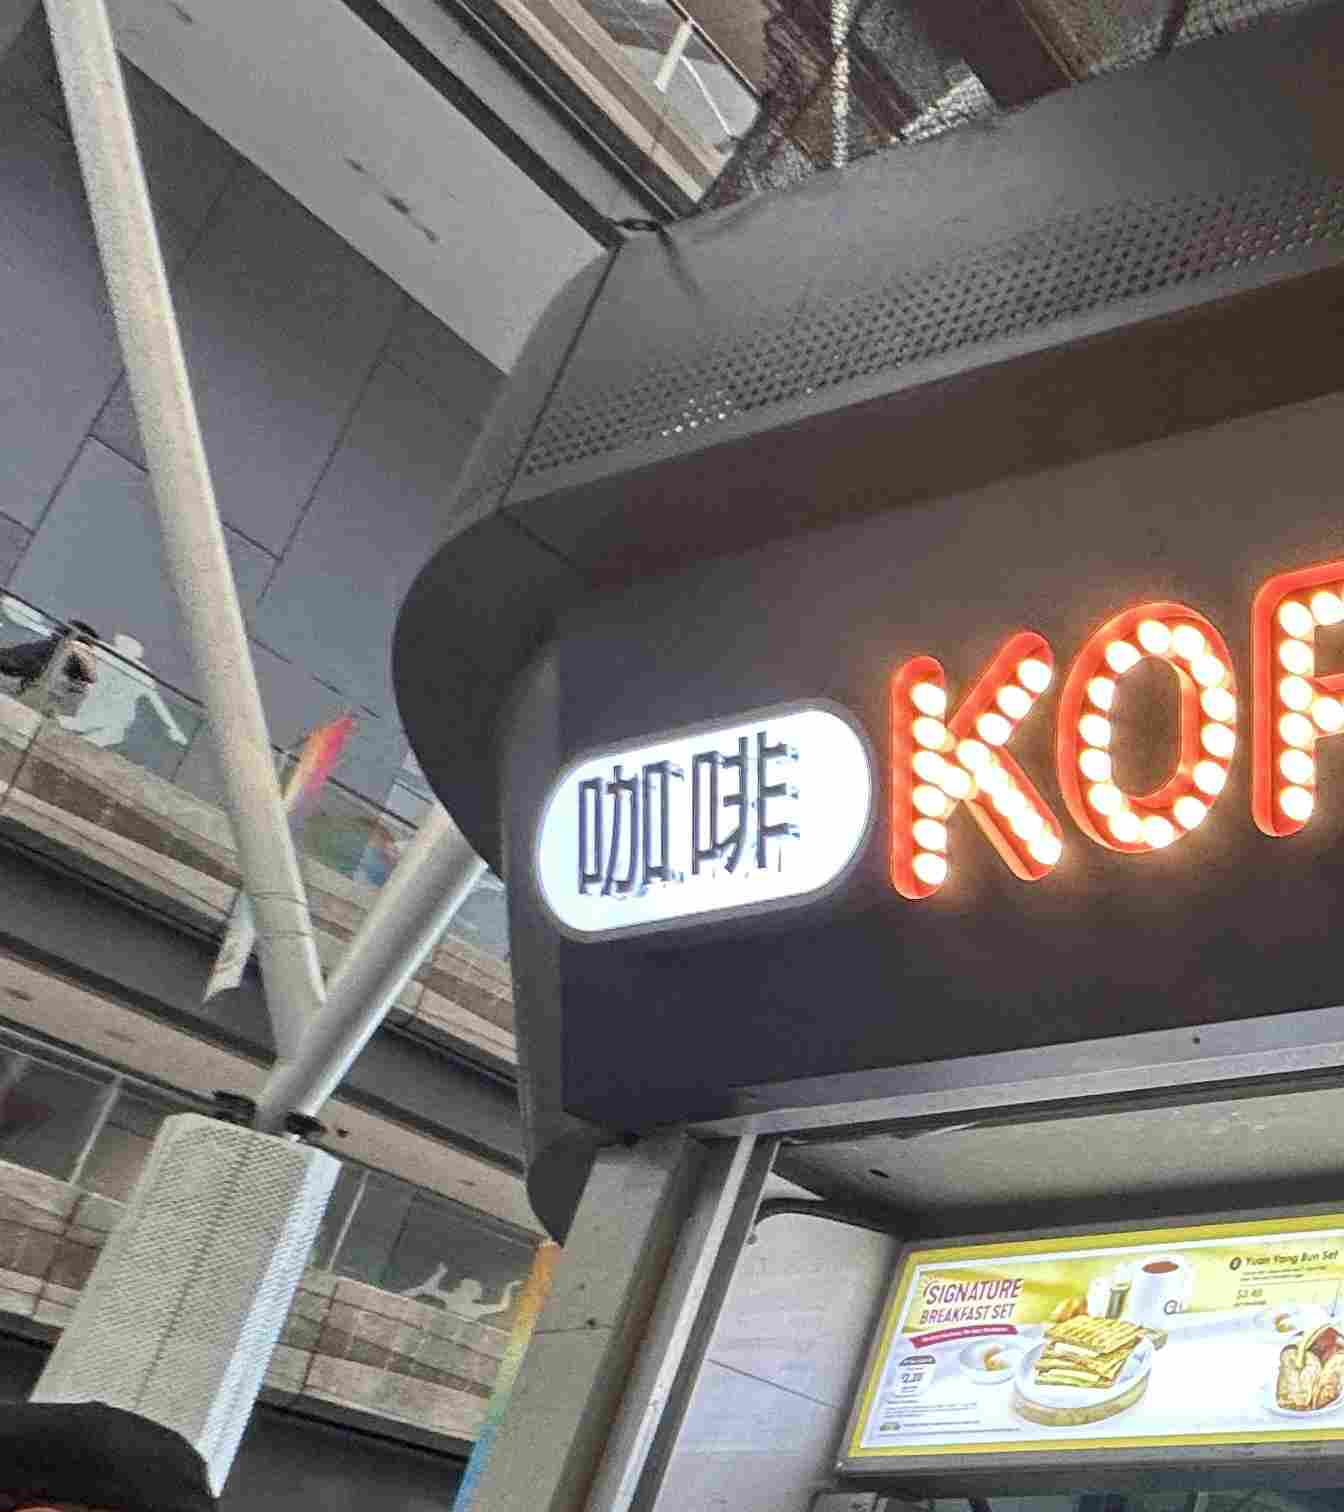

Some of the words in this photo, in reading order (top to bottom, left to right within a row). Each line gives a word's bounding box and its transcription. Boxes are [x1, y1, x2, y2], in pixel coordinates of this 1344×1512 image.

[575, 731, 799, 899] 咖啡
[926, 1278, 1023, 1305] SIGNATURE
[920, 1305, 991, 1324] BREAKFAST
[992, 1303, 1016, 1320] SET
